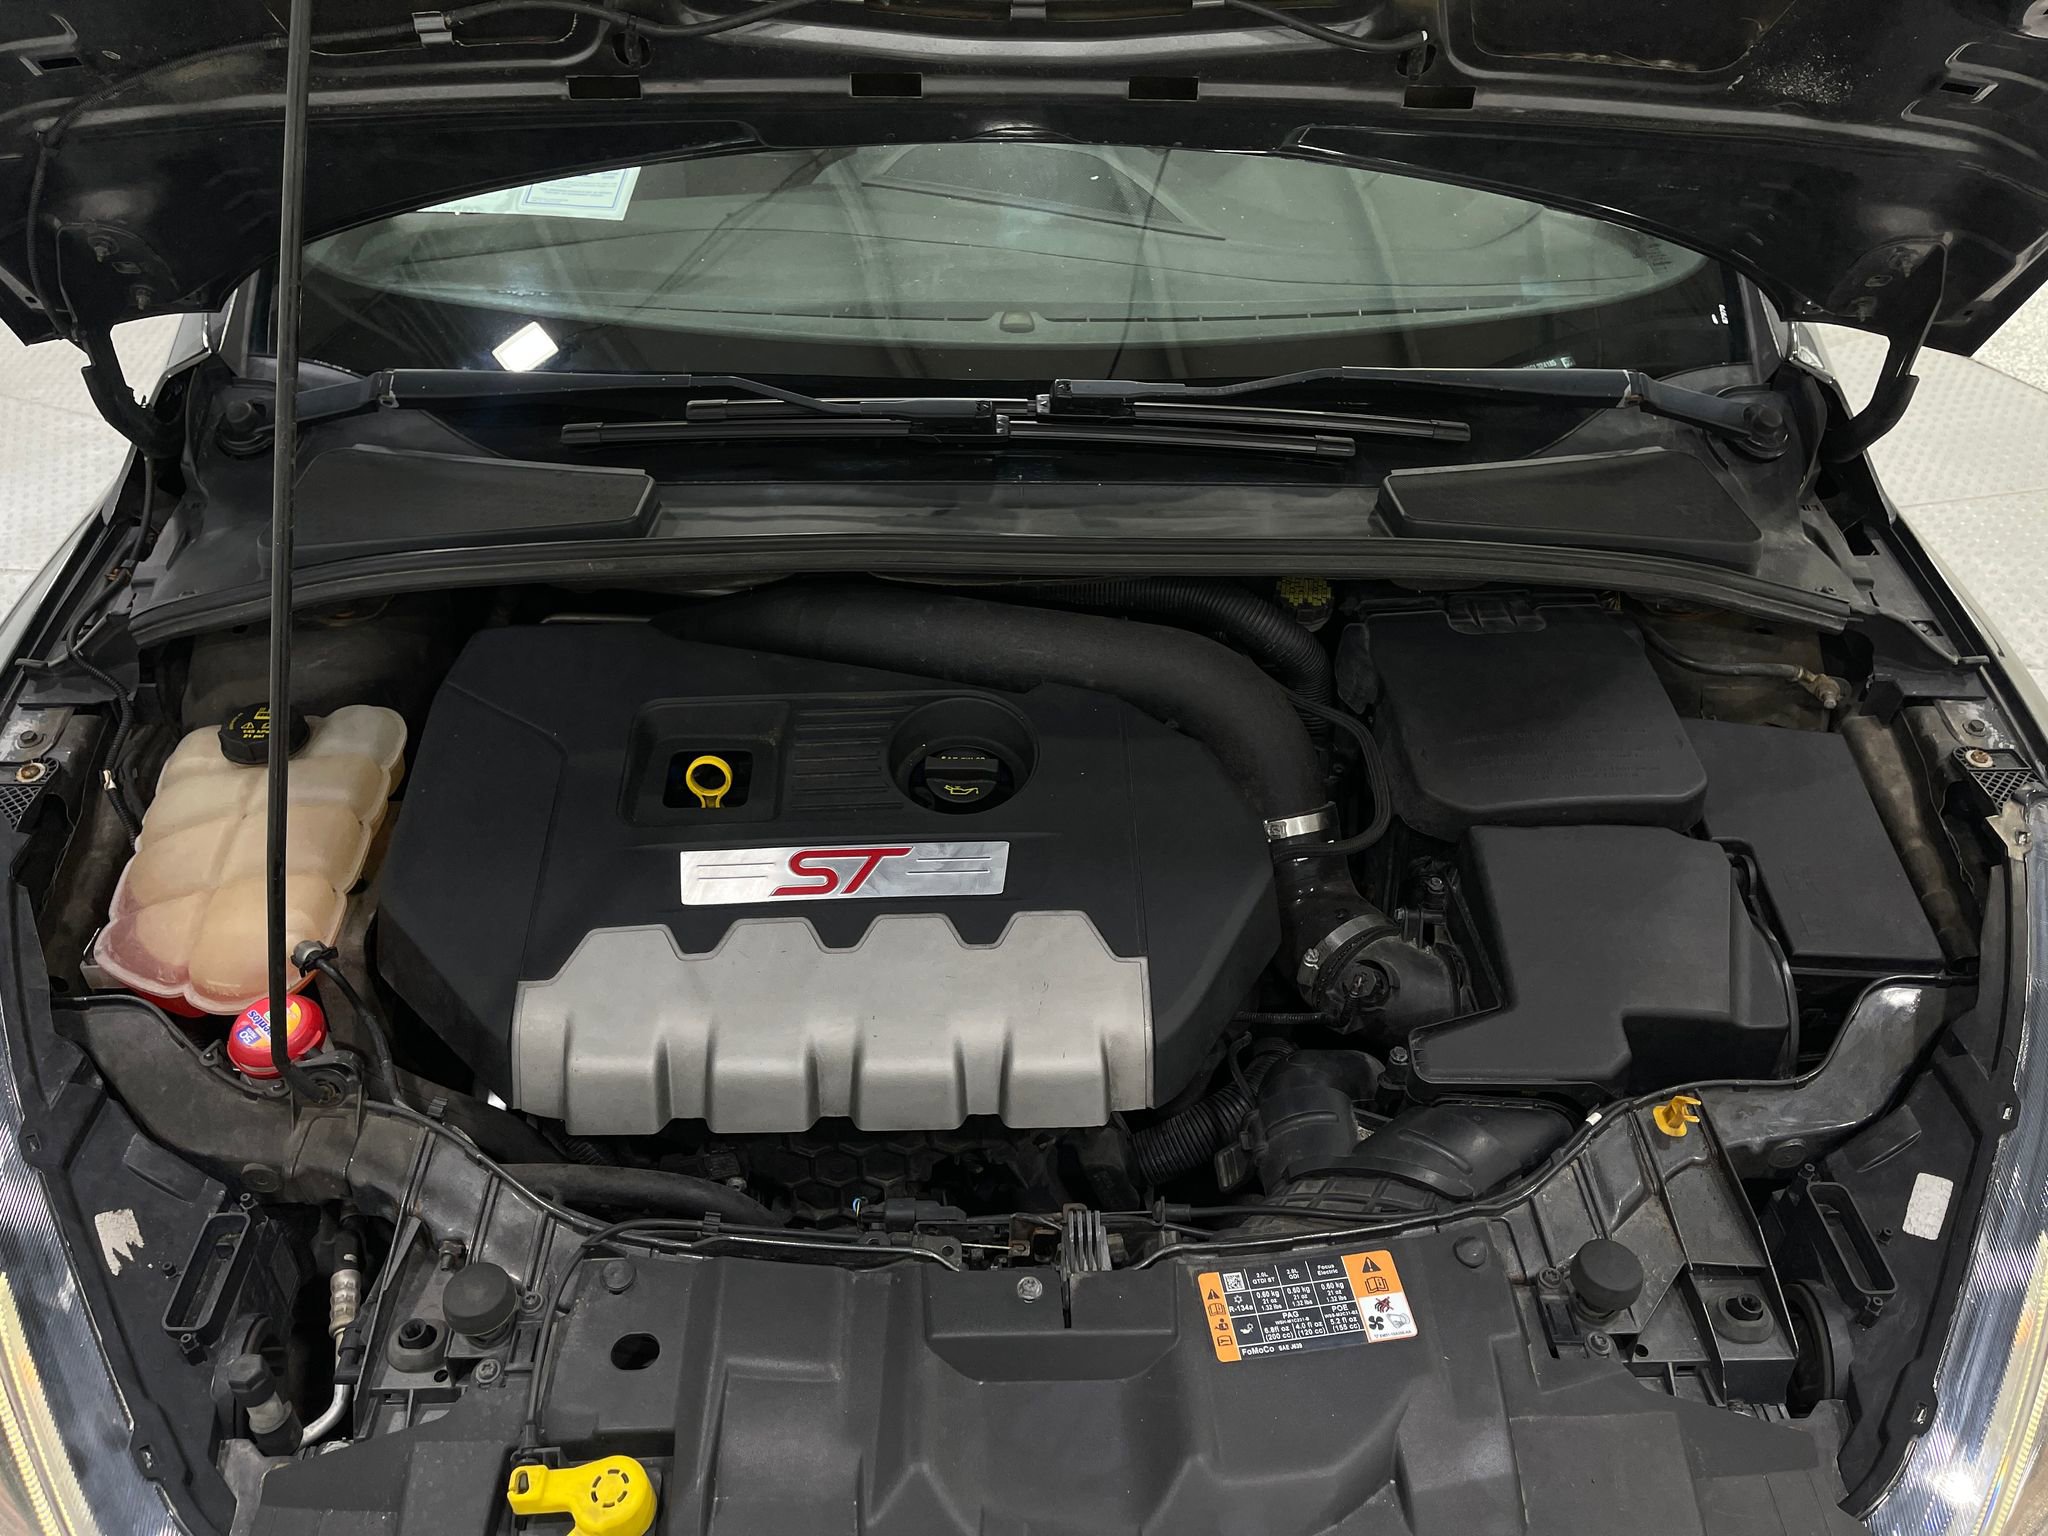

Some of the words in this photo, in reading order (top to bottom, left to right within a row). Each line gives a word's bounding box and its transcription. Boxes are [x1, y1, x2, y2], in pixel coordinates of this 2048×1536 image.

[769, 846, 914, 897] ST
[239, 1030, 253, 1045] 50
[1229, 1303, 1253, 1313] R-134a
[1331, 1304, 1348, 1312] POE
[1282, 1311, 1299, 1319] PAG
[1298, 1329, 1313, 1338] (120
[1333, 1324, 1348, 1333] (155
[1265, 1334, 1281, 1342] (200
[1282, 1331, 1294, 1339] cc)
[1242, 1346, 1275, 1356] FoMoCo
